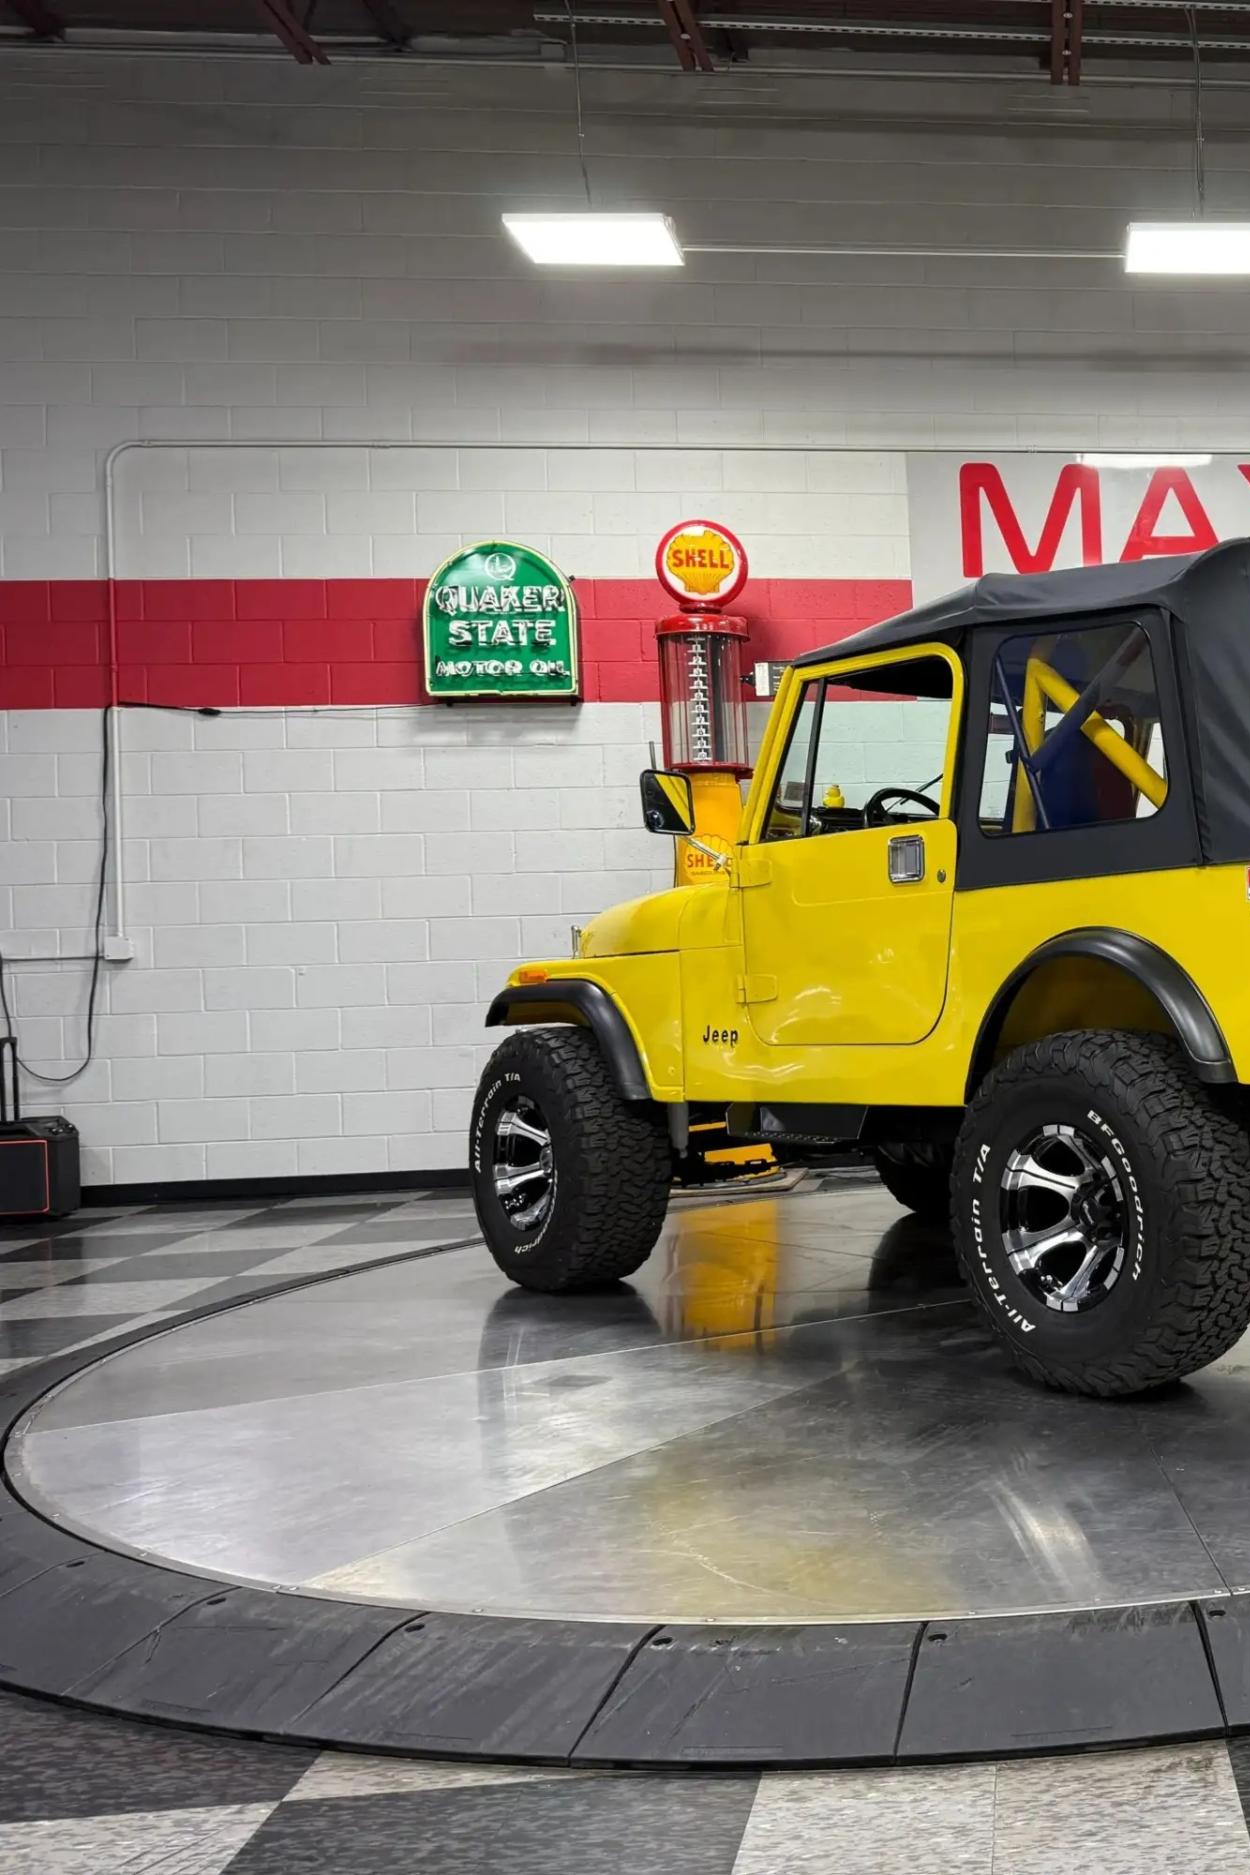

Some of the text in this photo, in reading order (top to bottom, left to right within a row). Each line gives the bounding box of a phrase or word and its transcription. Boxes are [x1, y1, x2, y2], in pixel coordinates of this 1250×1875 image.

[671, 549, 730, 568] SHELL
[435, 585, 566, 616] QUAKER
[448, 619, 557, 646] STATE
[436, 659, 570, 677] MOTOR OIL
[703, 1025, 738, 1048] Jeep
[474, 1073, 520, 1173] All-Terrain T/A
[1087, 1110, 1144, 1281] BFGoodrich
[972, 1143, 1036, 1333] All-Terrain T/A
